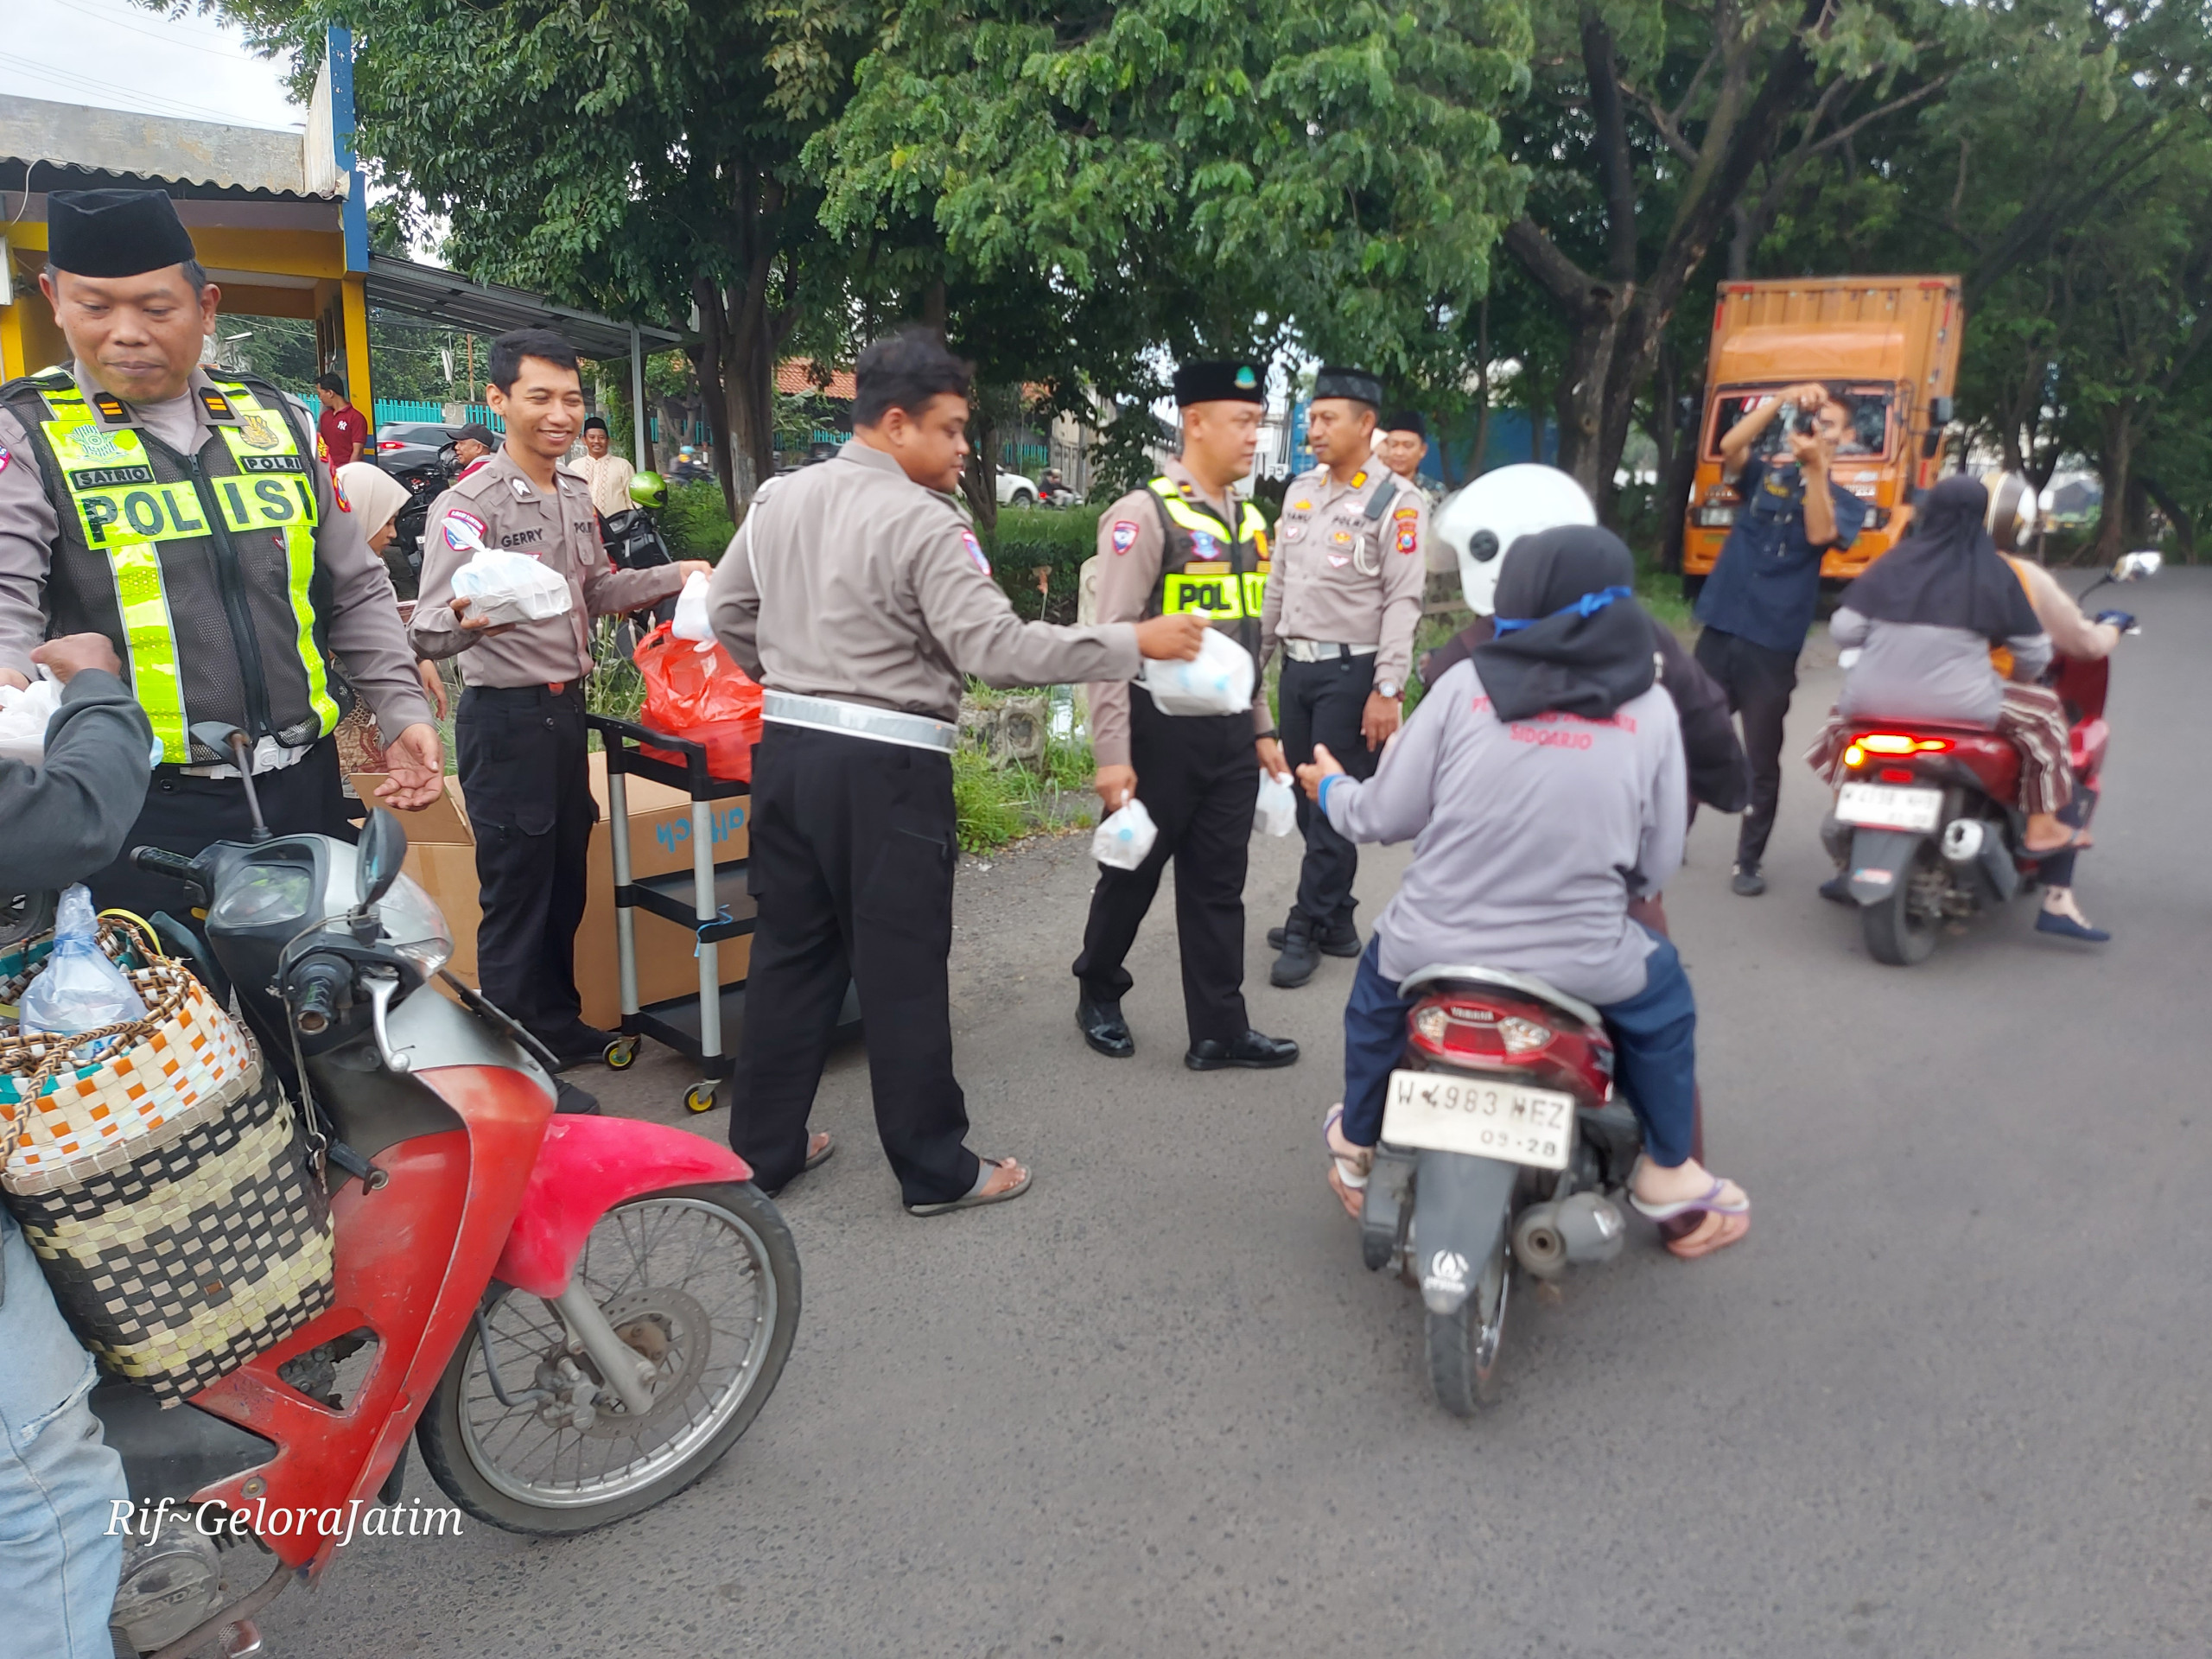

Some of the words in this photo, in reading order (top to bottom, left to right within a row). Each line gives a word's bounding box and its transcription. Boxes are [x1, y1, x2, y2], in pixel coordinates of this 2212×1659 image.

[249, 457, 302, 470] POLRI
[82, 467, 146, 485] SATRIO
[81, 480, 314, 543] POLISI
[501, 528, 543, 548] GERRY
[1398, 1080, 1414, 1105] W
